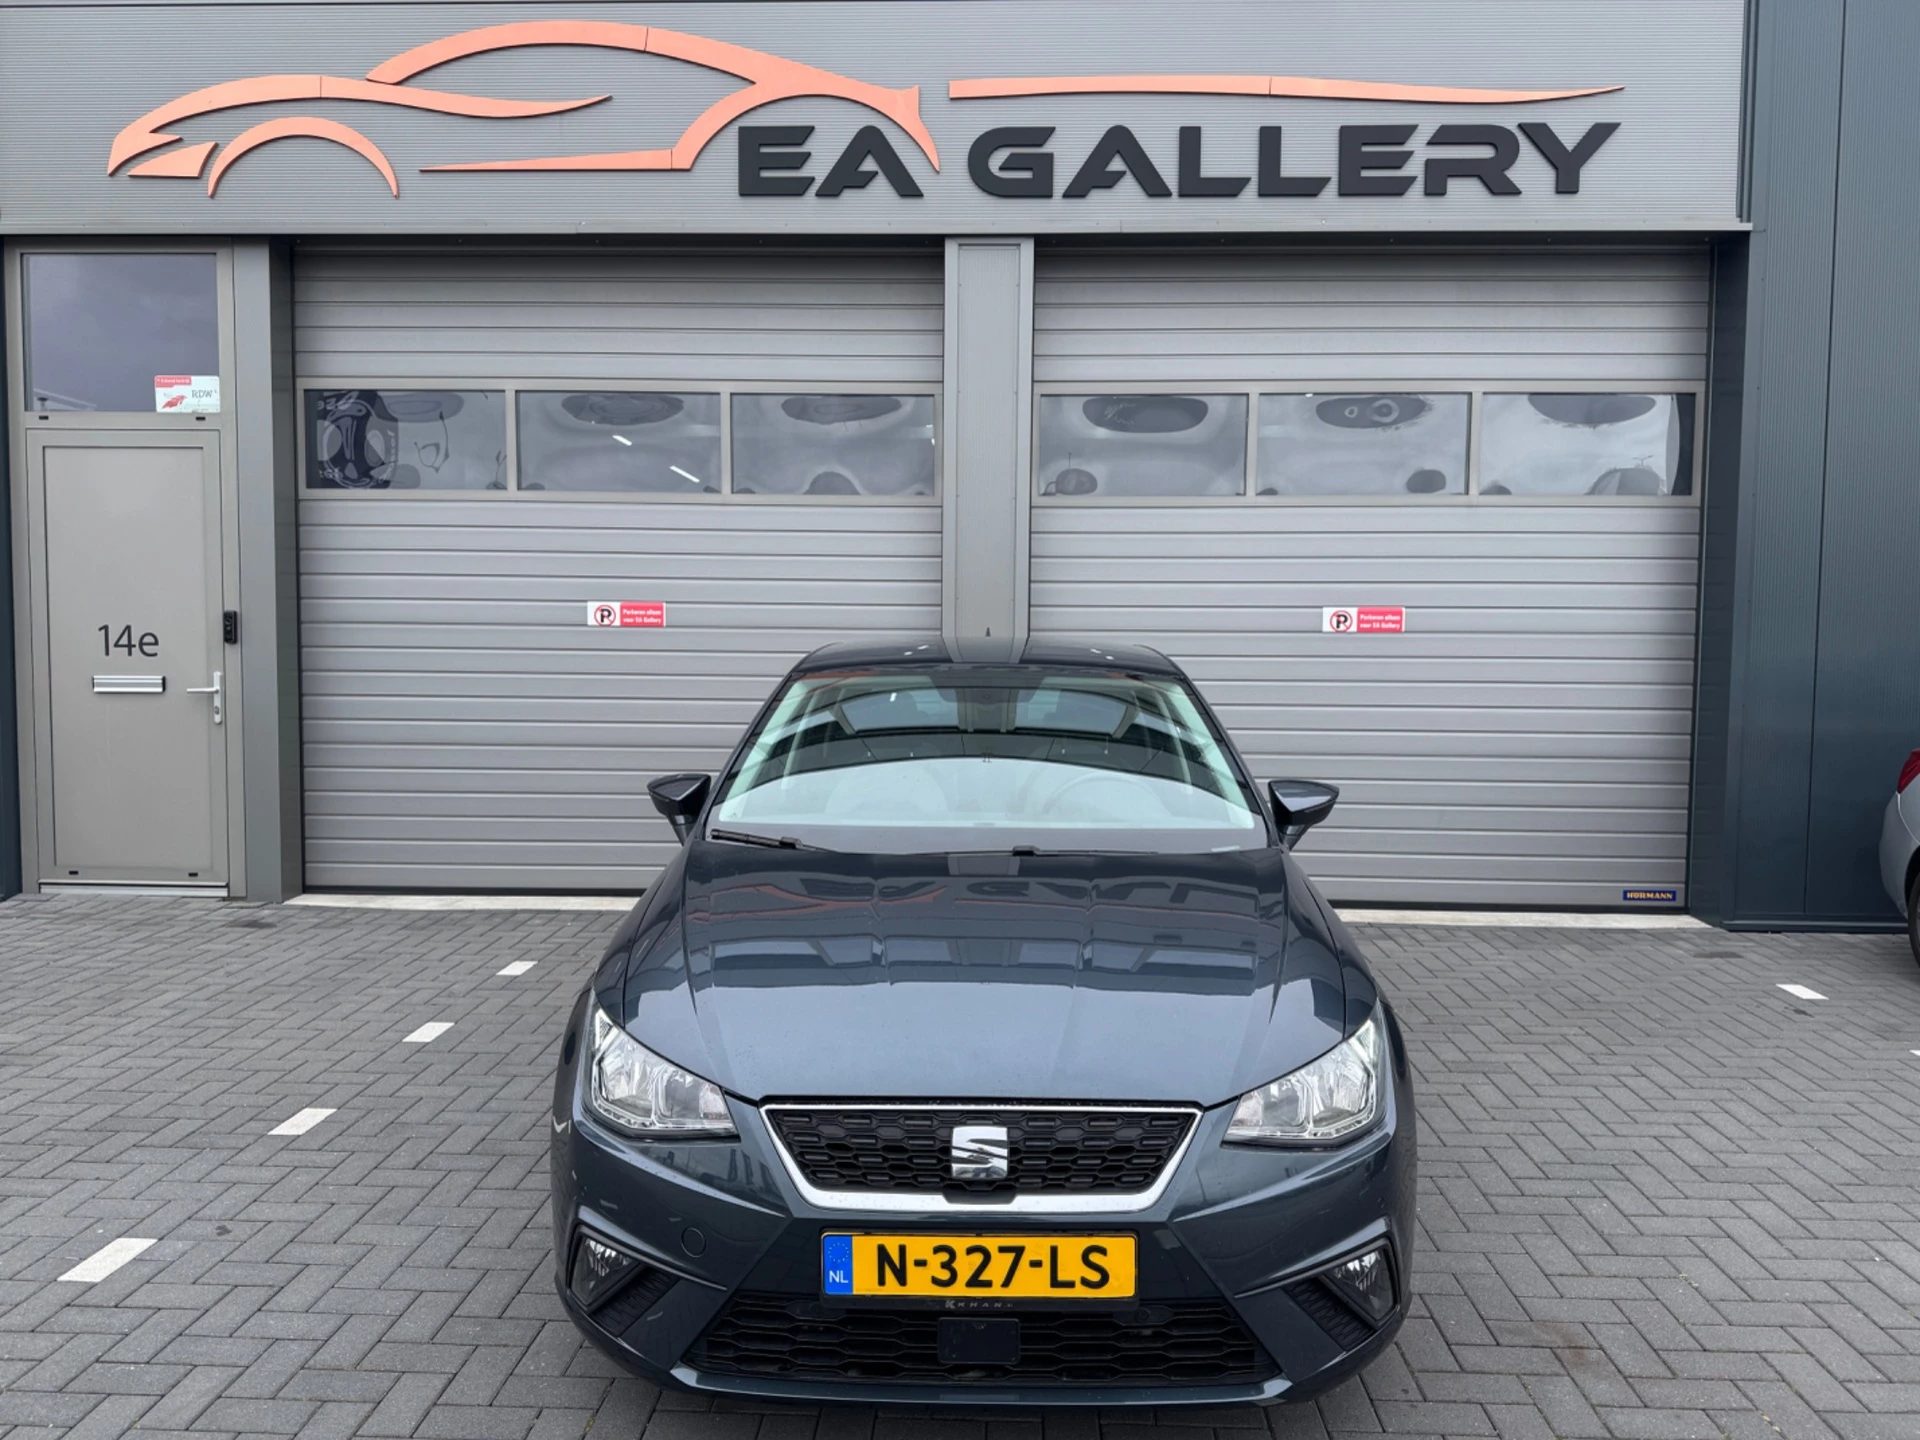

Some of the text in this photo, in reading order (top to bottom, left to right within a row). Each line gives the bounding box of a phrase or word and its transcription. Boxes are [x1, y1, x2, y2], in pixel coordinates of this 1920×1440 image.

[737, 121, 1622, 199] EA GALLERY
[191, 389, 213, 399] RDW
[98, 624, 159, 657] 14e
[828, 1243, 1111, 1290] NL N-327-LS
